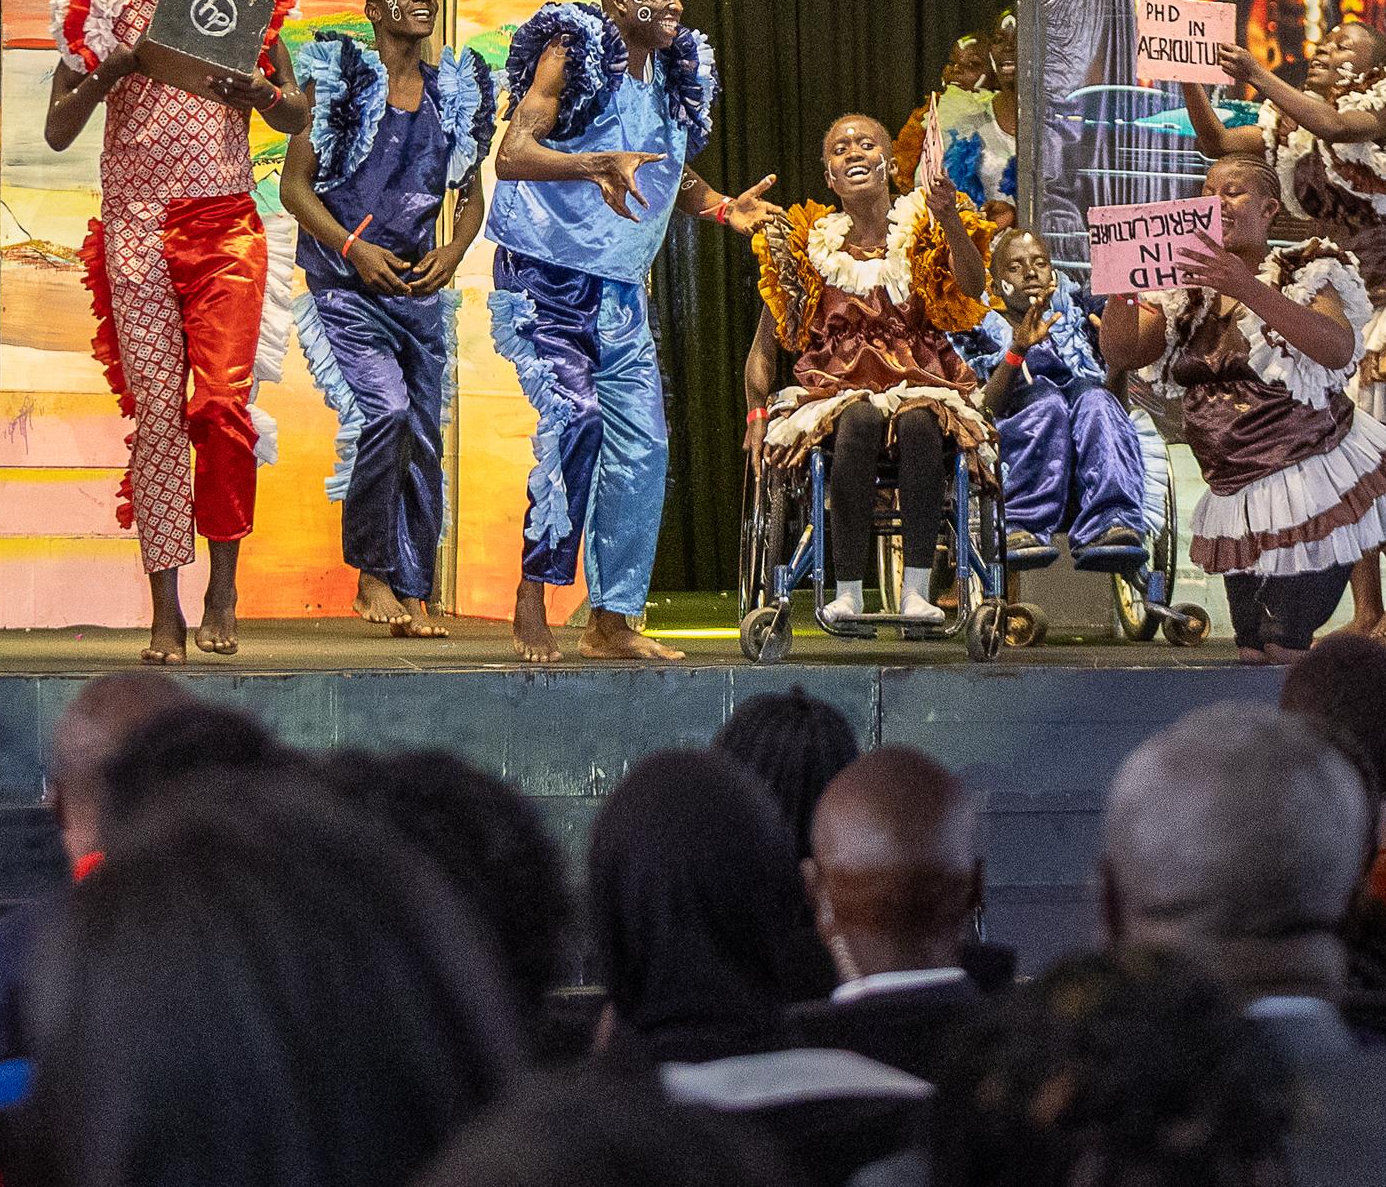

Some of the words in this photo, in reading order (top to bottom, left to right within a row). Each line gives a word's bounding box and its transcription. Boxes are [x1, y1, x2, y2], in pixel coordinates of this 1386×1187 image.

[1146, 2, 1180, 22] PHD
[1188, 20, 1205, 37] IN
[1089, 206, 1214, 245] AGRICULTURE
[1139, 242, 1173, 264] IN
[1128, 267, 1183, 289] HD
